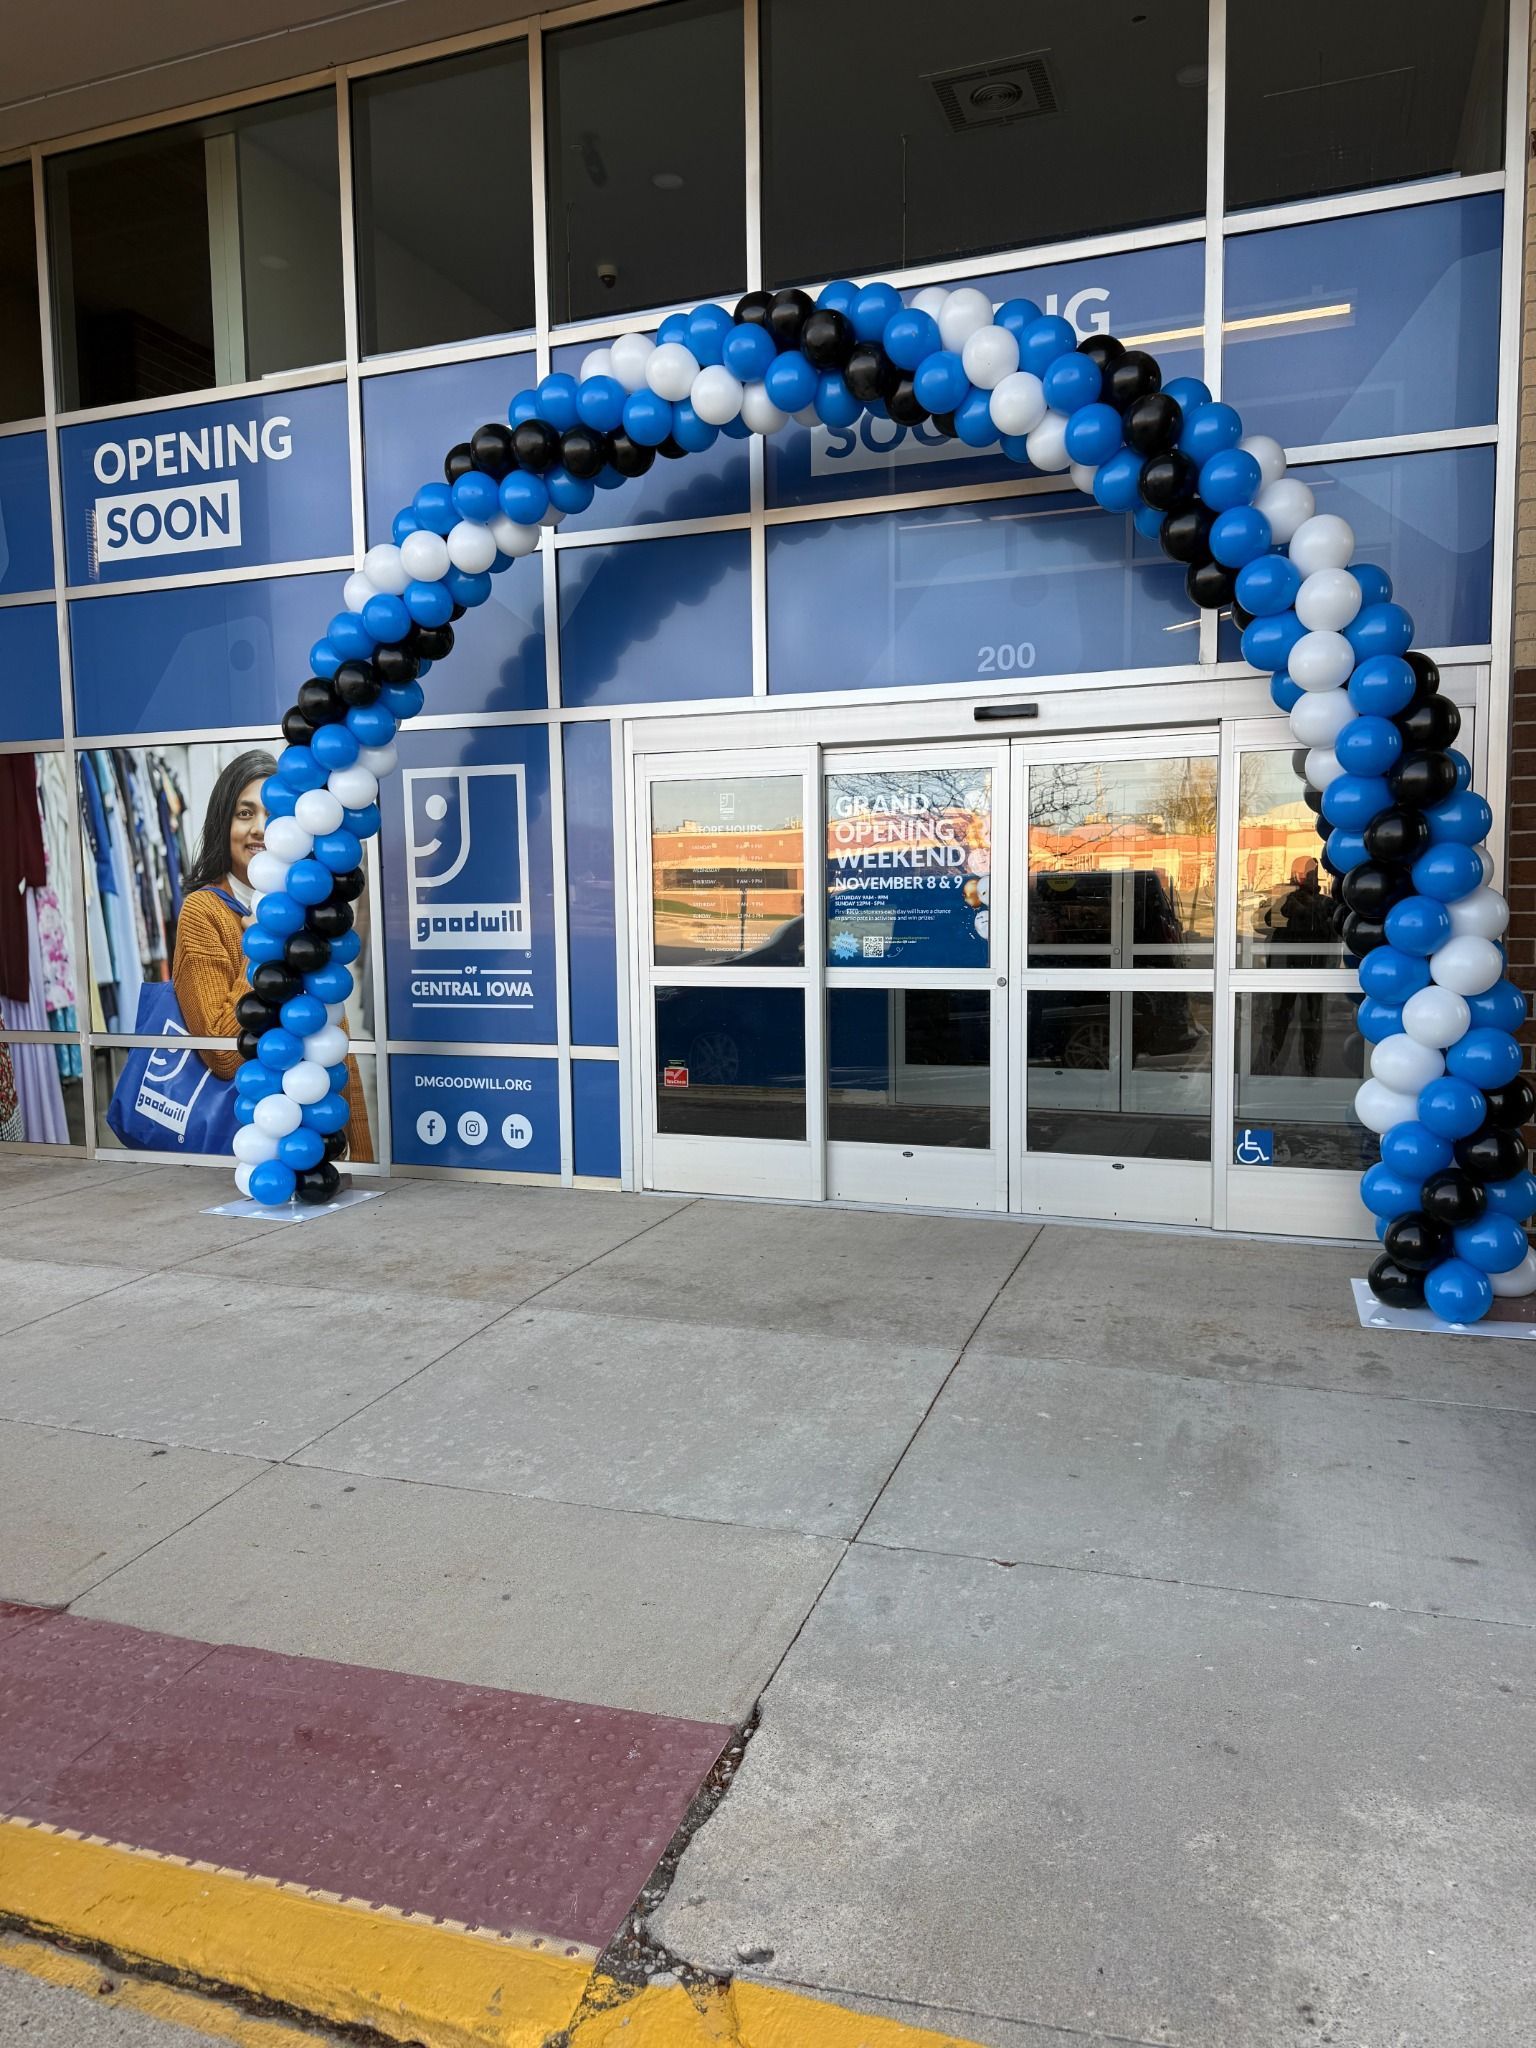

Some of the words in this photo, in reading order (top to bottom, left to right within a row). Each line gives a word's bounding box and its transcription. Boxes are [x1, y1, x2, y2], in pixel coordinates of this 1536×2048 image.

[93, 416, 292, 485] OPENING
[107, 492, 230, 549] SOON
[977, 642, 1036, 673] 200
[836, 793, 929, 817] GRAND
[835, 819, 955, 843] OPENING
[835, 845, 966, 868] WEEKEND
[835, 876, 922, 890] NOVEMBER
[926, 876, 936, 889] 8
[939, 876, 950, 889] &
[954, 876, 963, 889] 9
[896, 908, 906, 916] day
[417, 910, 523, 942] goodwill
[464, 966, 477, 975] OF
[411, 981, 481, 997] CENTRAL
[486, 981, 534, 997] IOWA
[415, 1075, 532, 1091] DMGOODWILL.ORG
[137, 1093, 186, 1123] goodwill
